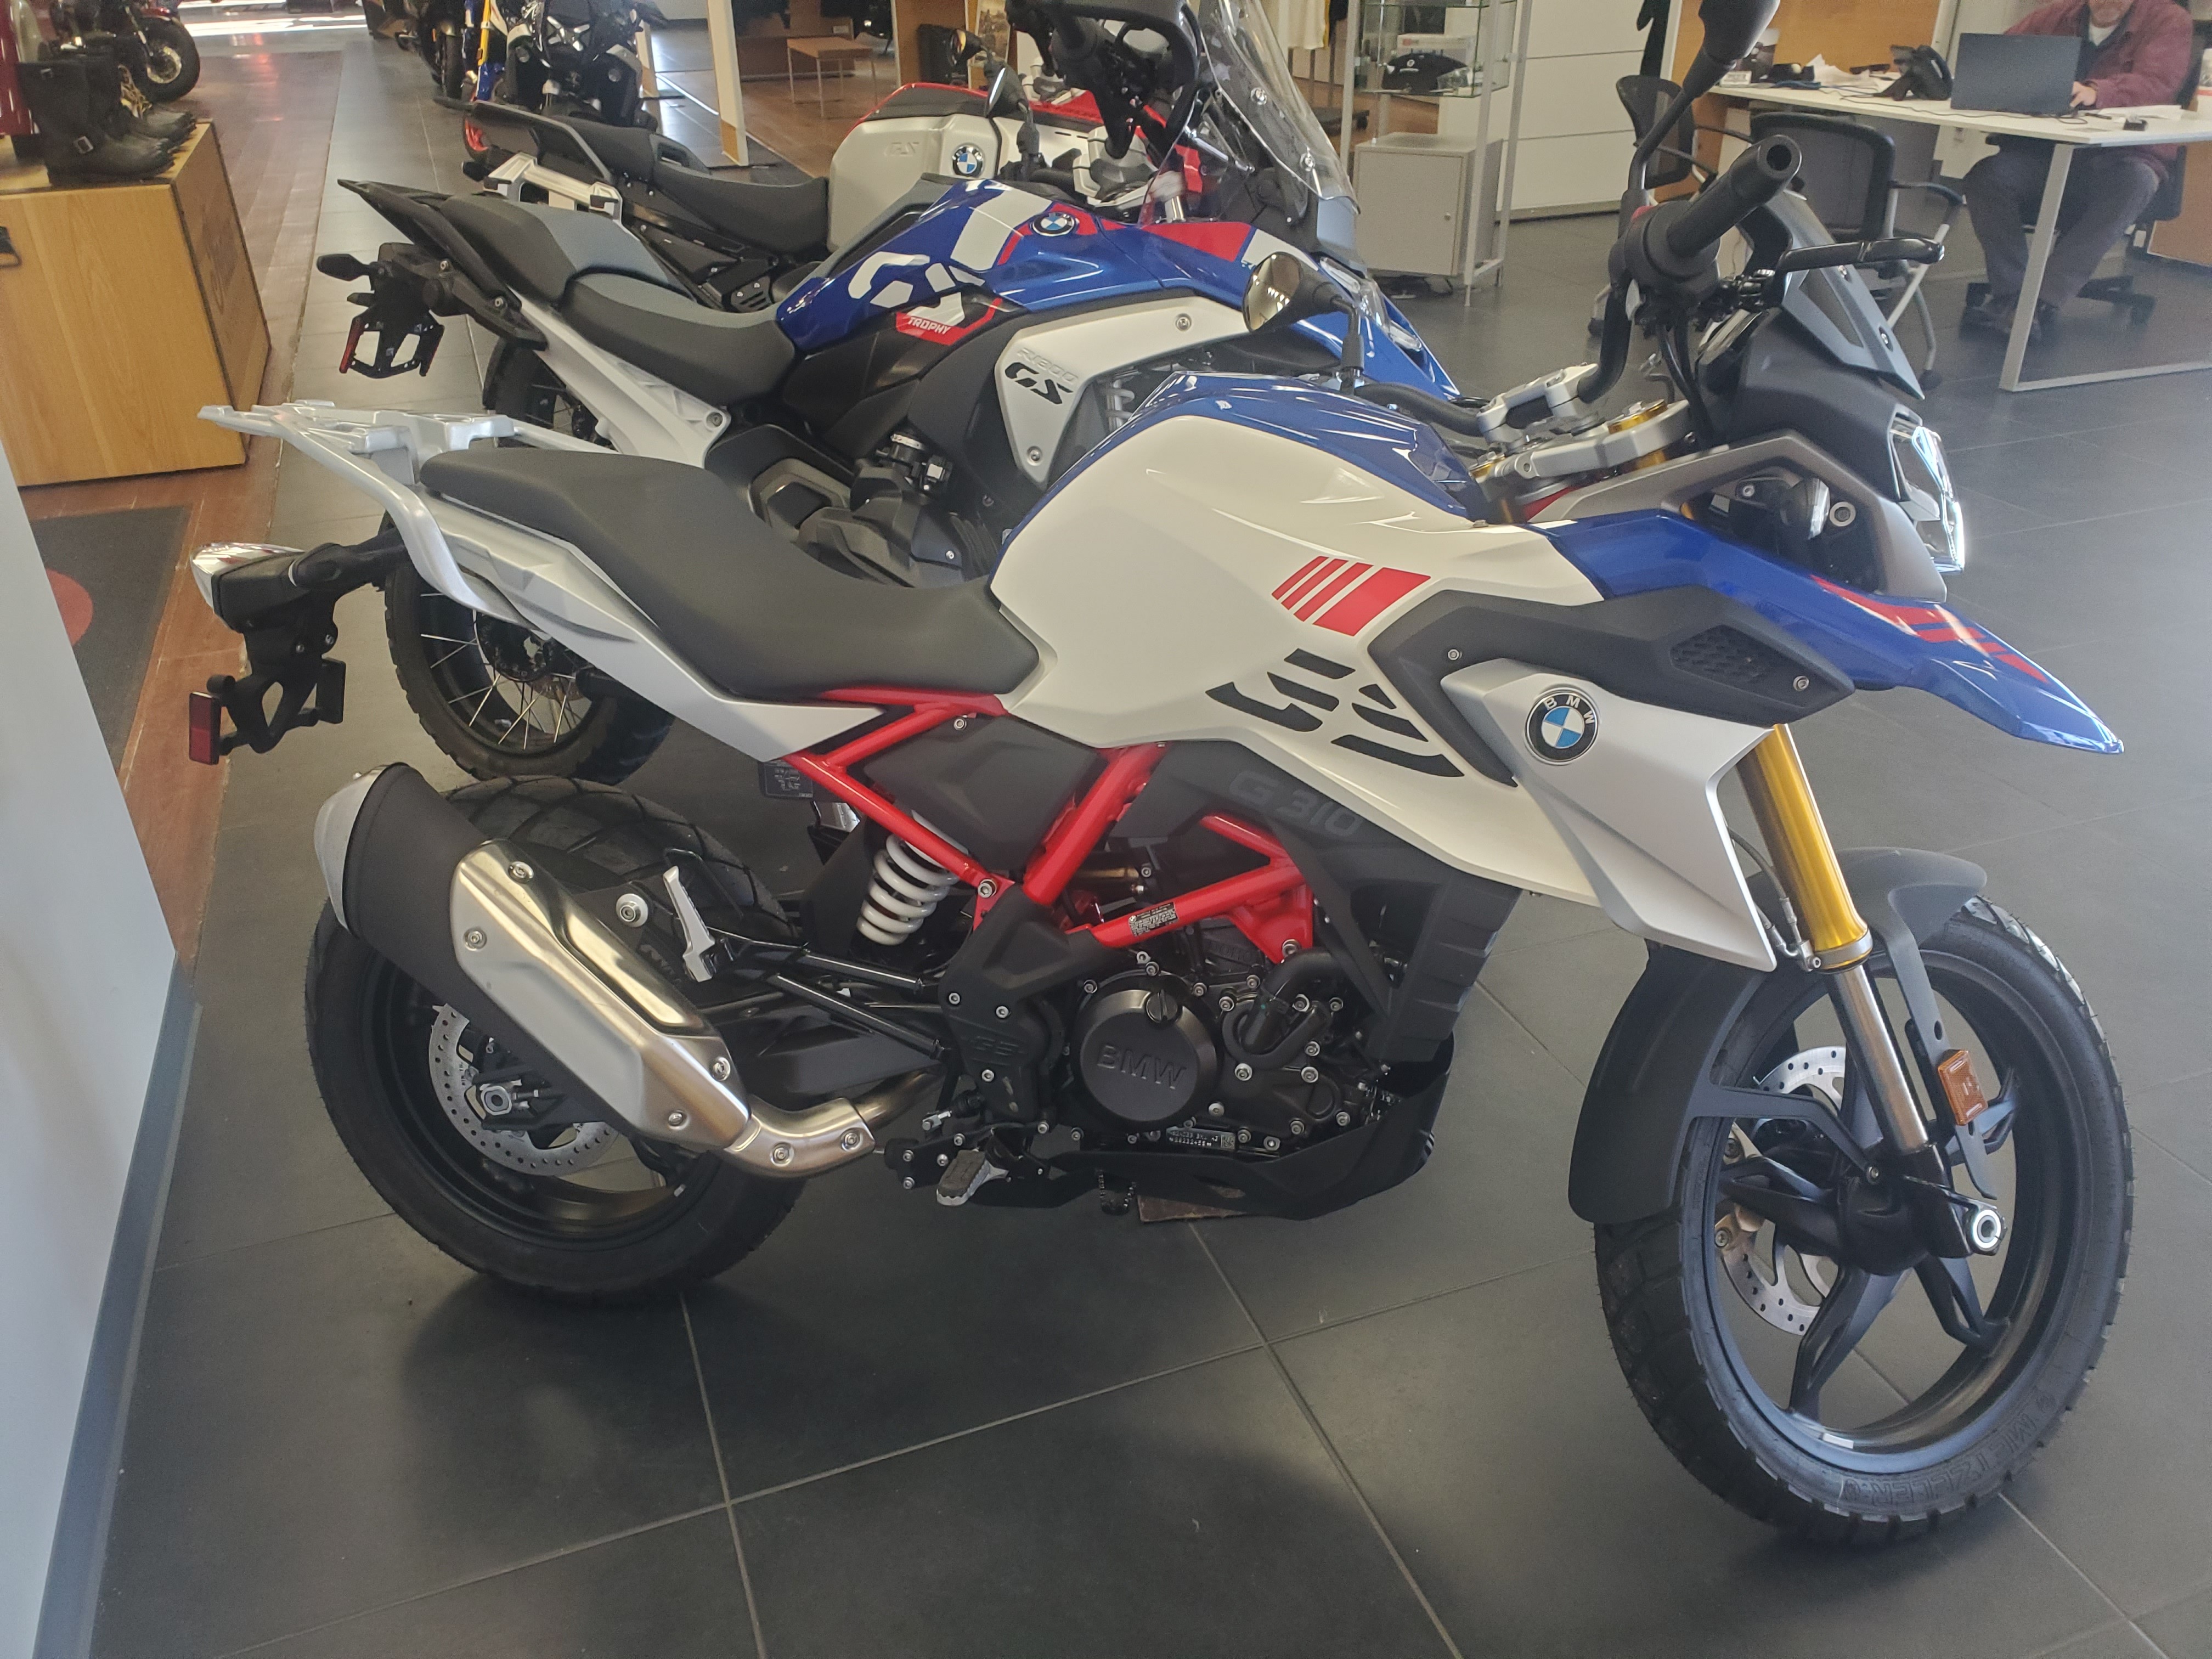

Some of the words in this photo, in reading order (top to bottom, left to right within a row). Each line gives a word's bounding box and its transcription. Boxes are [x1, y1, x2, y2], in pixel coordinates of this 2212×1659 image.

[908, 317, 951, 335] TROPHY
[1543, 695, 1595, 725] BMW
[1229, 770, 1280, 805] G
[1274, 789, 1364, 837] 310
[1097, 1043, 1187, 1090] BMW
